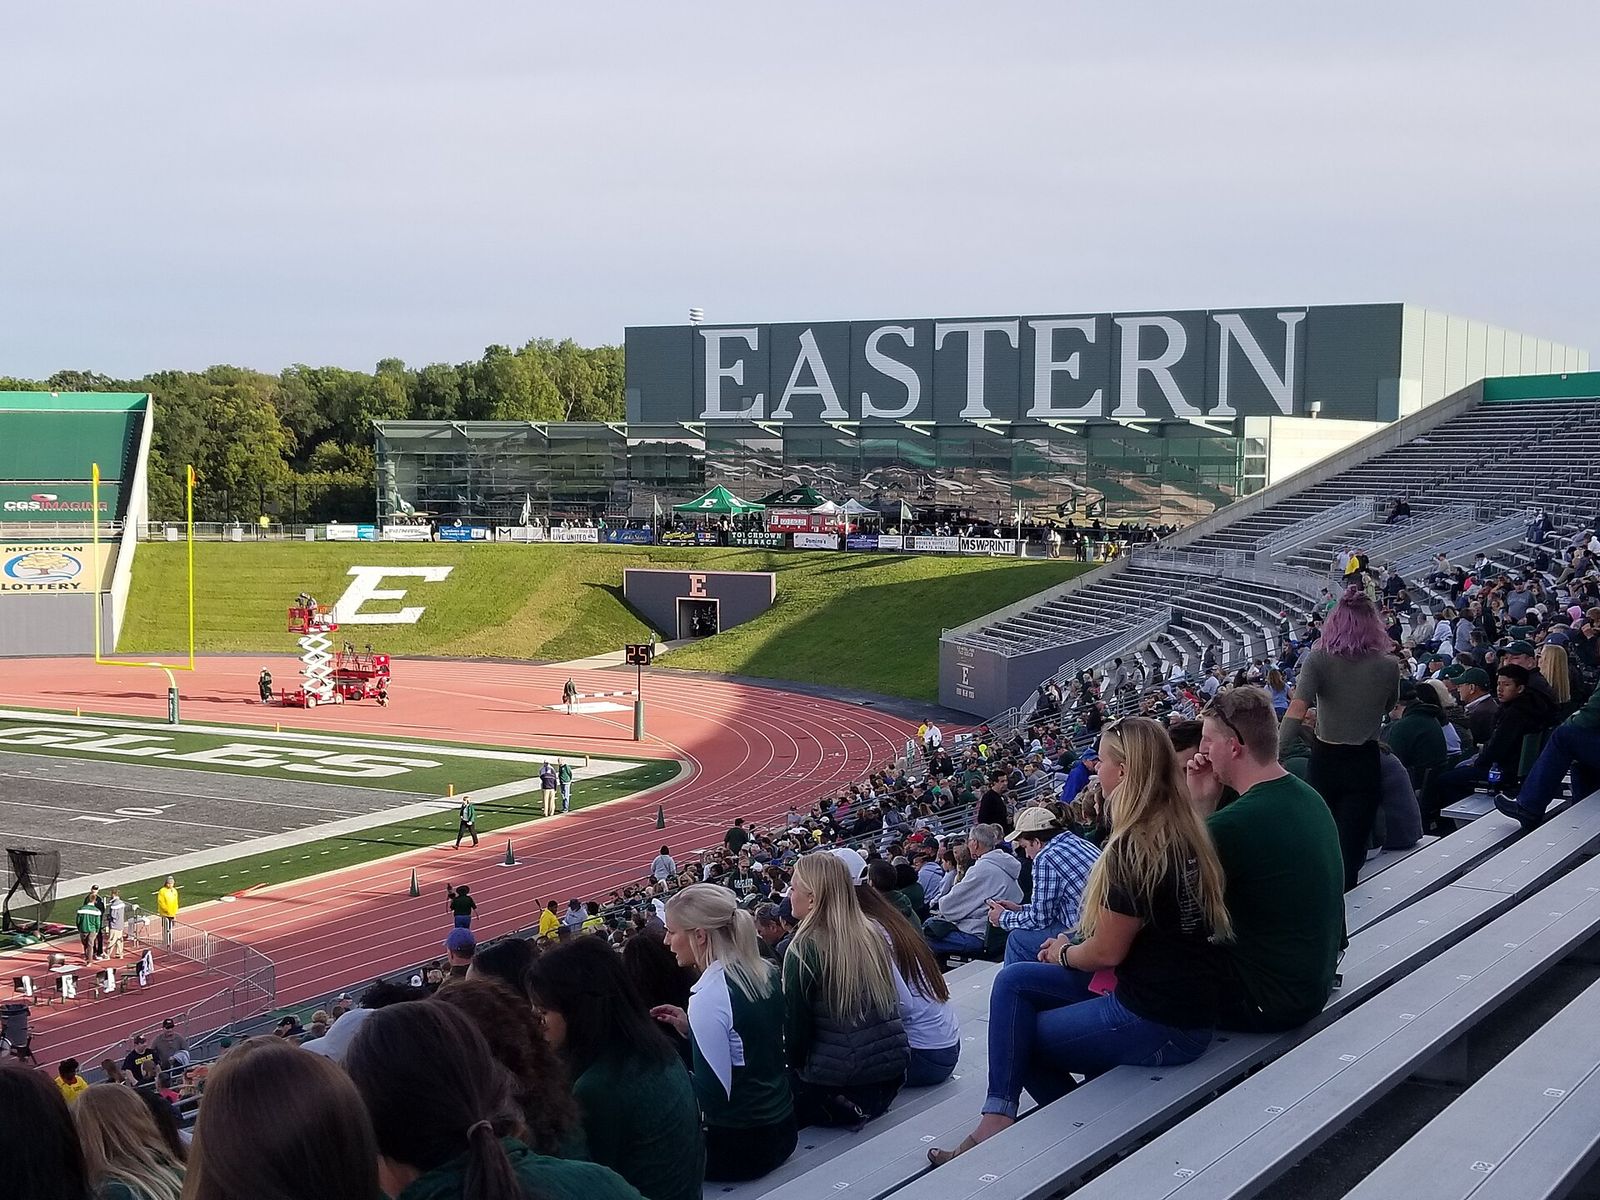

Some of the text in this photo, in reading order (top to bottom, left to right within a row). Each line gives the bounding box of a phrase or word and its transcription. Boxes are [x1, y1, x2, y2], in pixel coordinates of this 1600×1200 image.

[699, 311, 1307, 419] EASTERN
[4, 501, 40, 509] CGS
[498, 528, 511, 540] M
[552, 533, 587, 541] LIVE UNITED
[737, 538, 778, 546] TERRACE
[1, 583, 81, 591] LOTTERY
[689, 575, 707, 596] E
[332, 566, 454, 625] E
[627, 646, 647, 663] 25
[962, 666, 969, 686] E
[69, 806, 164, 825] 10
